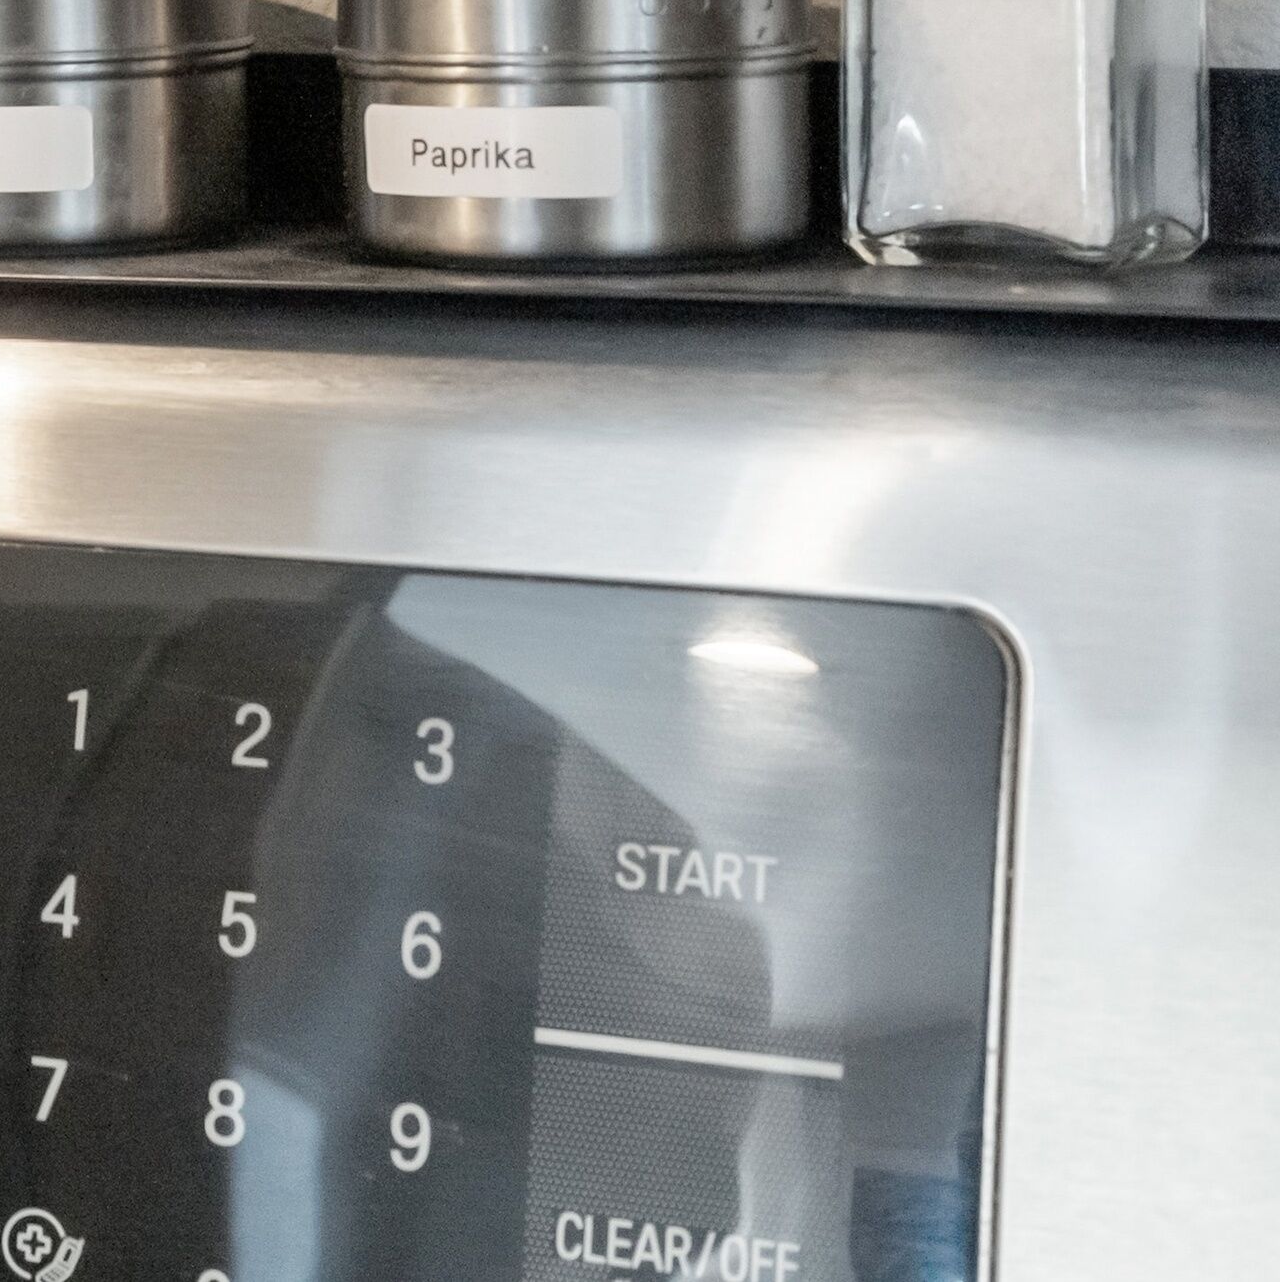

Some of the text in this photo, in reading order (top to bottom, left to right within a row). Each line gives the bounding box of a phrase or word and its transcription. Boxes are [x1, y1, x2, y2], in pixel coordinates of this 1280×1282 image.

[411, 138, 535, 175] Paprika
[67, 688, 89, 751] 1
[231, 702, 272, 768] 2
[413, 717, 455, 785] 3
[40, 874, 80, 939] 4
[615, 841, 780, 905] START
[218, 891, 257, 958] 5
[401, 911, 442, 979] 6
[30, 1055, 69, 1122] 7
[204, 1077, 246, 1148] 8
[390, 1102, 432, 1172] 9
